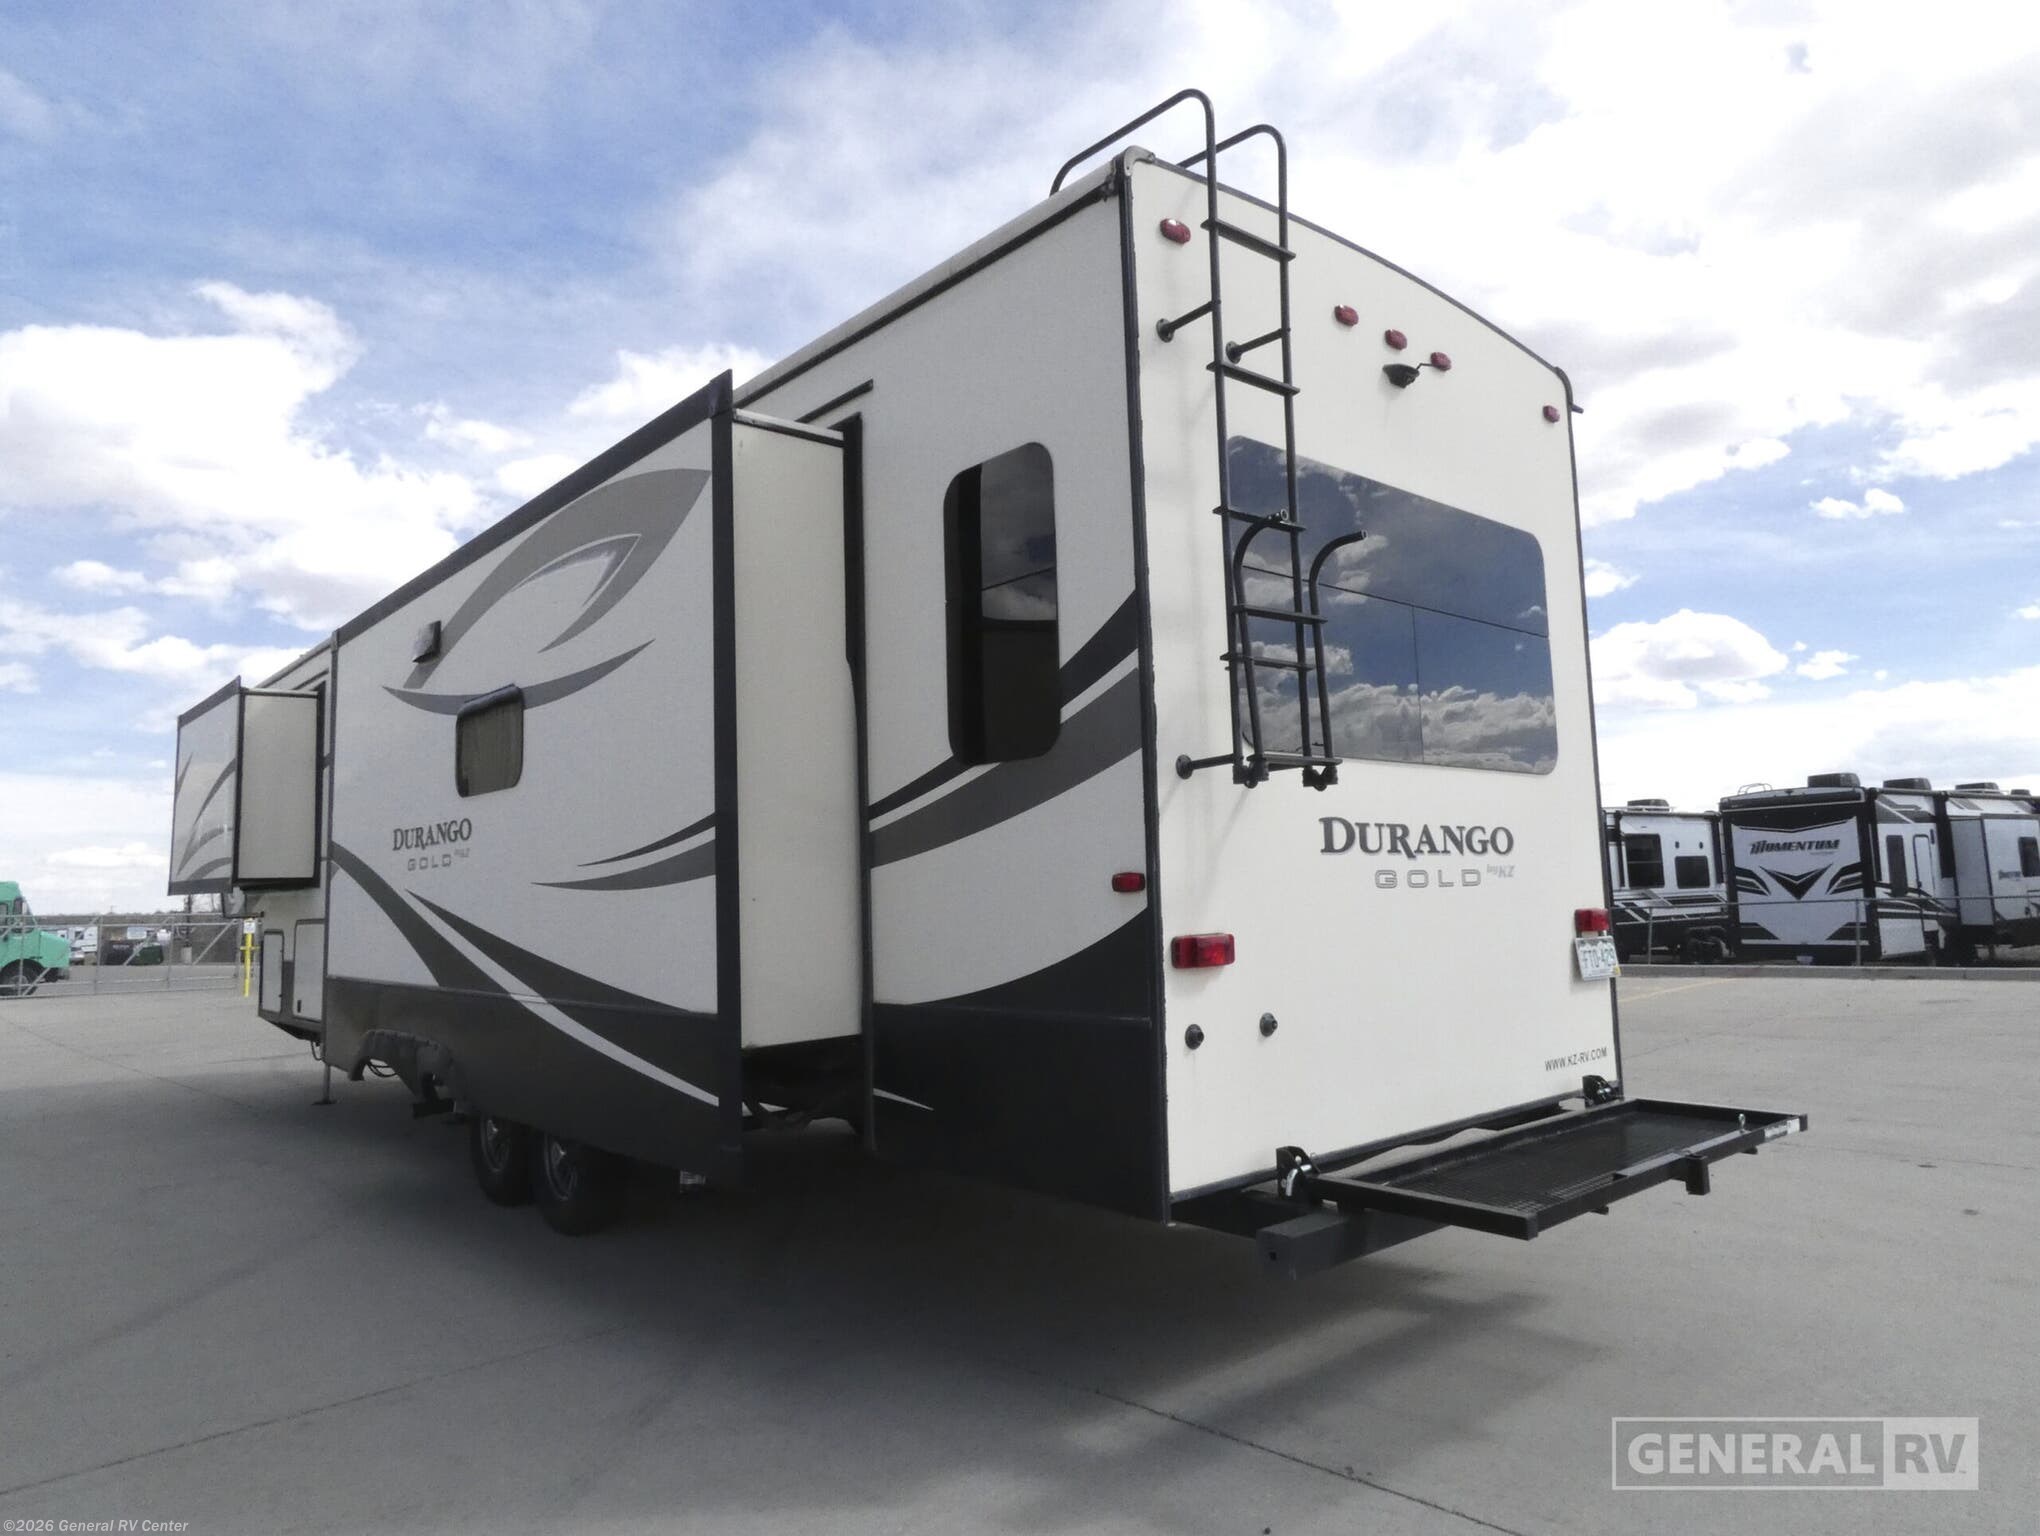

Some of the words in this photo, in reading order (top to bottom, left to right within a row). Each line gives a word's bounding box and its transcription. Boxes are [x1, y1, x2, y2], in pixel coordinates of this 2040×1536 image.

[392, 818, 472, 851] DURANGO
[1318, 816, 1515, 859] DURANGO
[1749, 839, 1840, 856] MOMENTUM
[407, 854, 452, 872] GOLD
[1374, 868, 1482, 889] GOLD
[1544, 1046, 1607, 1072] WWW.KZ-RV.COM
